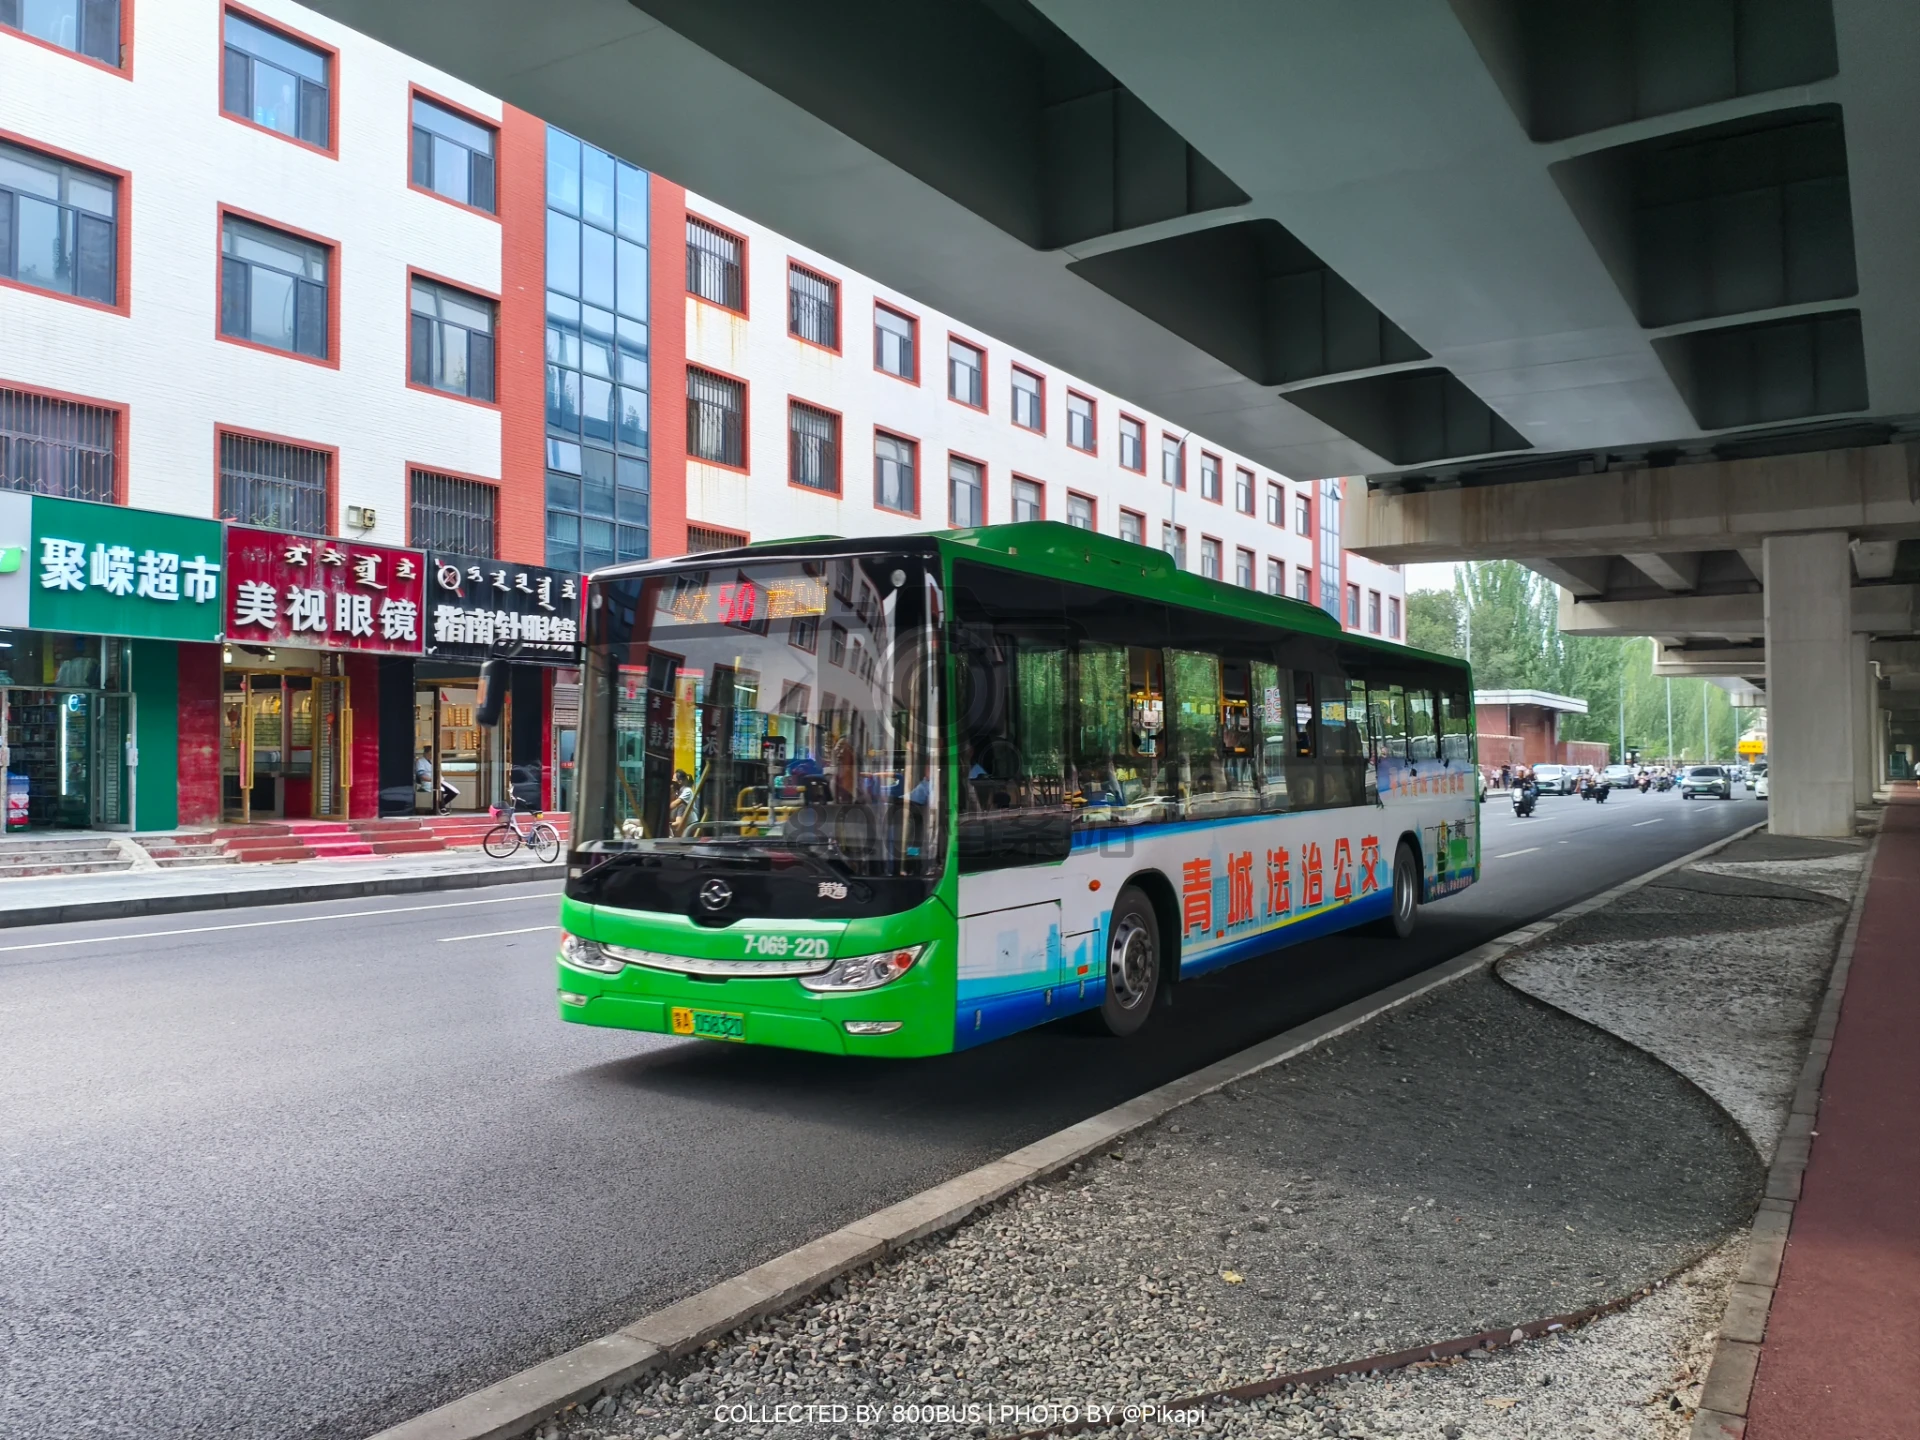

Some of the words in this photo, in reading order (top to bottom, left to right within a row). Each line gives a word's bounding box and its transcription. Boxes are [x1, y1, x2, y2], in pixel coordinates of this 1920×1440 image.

[40, 537, 220, 604] 聚嵘超市
[235, 580, 418, 642] 美视眼镜
[433, 604, 577, 652] 指南针眼镜
[718, 582, 757, 623] 50
[1182, 834, 1380, 939] 青城法治公交
[743, 934, 830, 959] 7-069-22D
